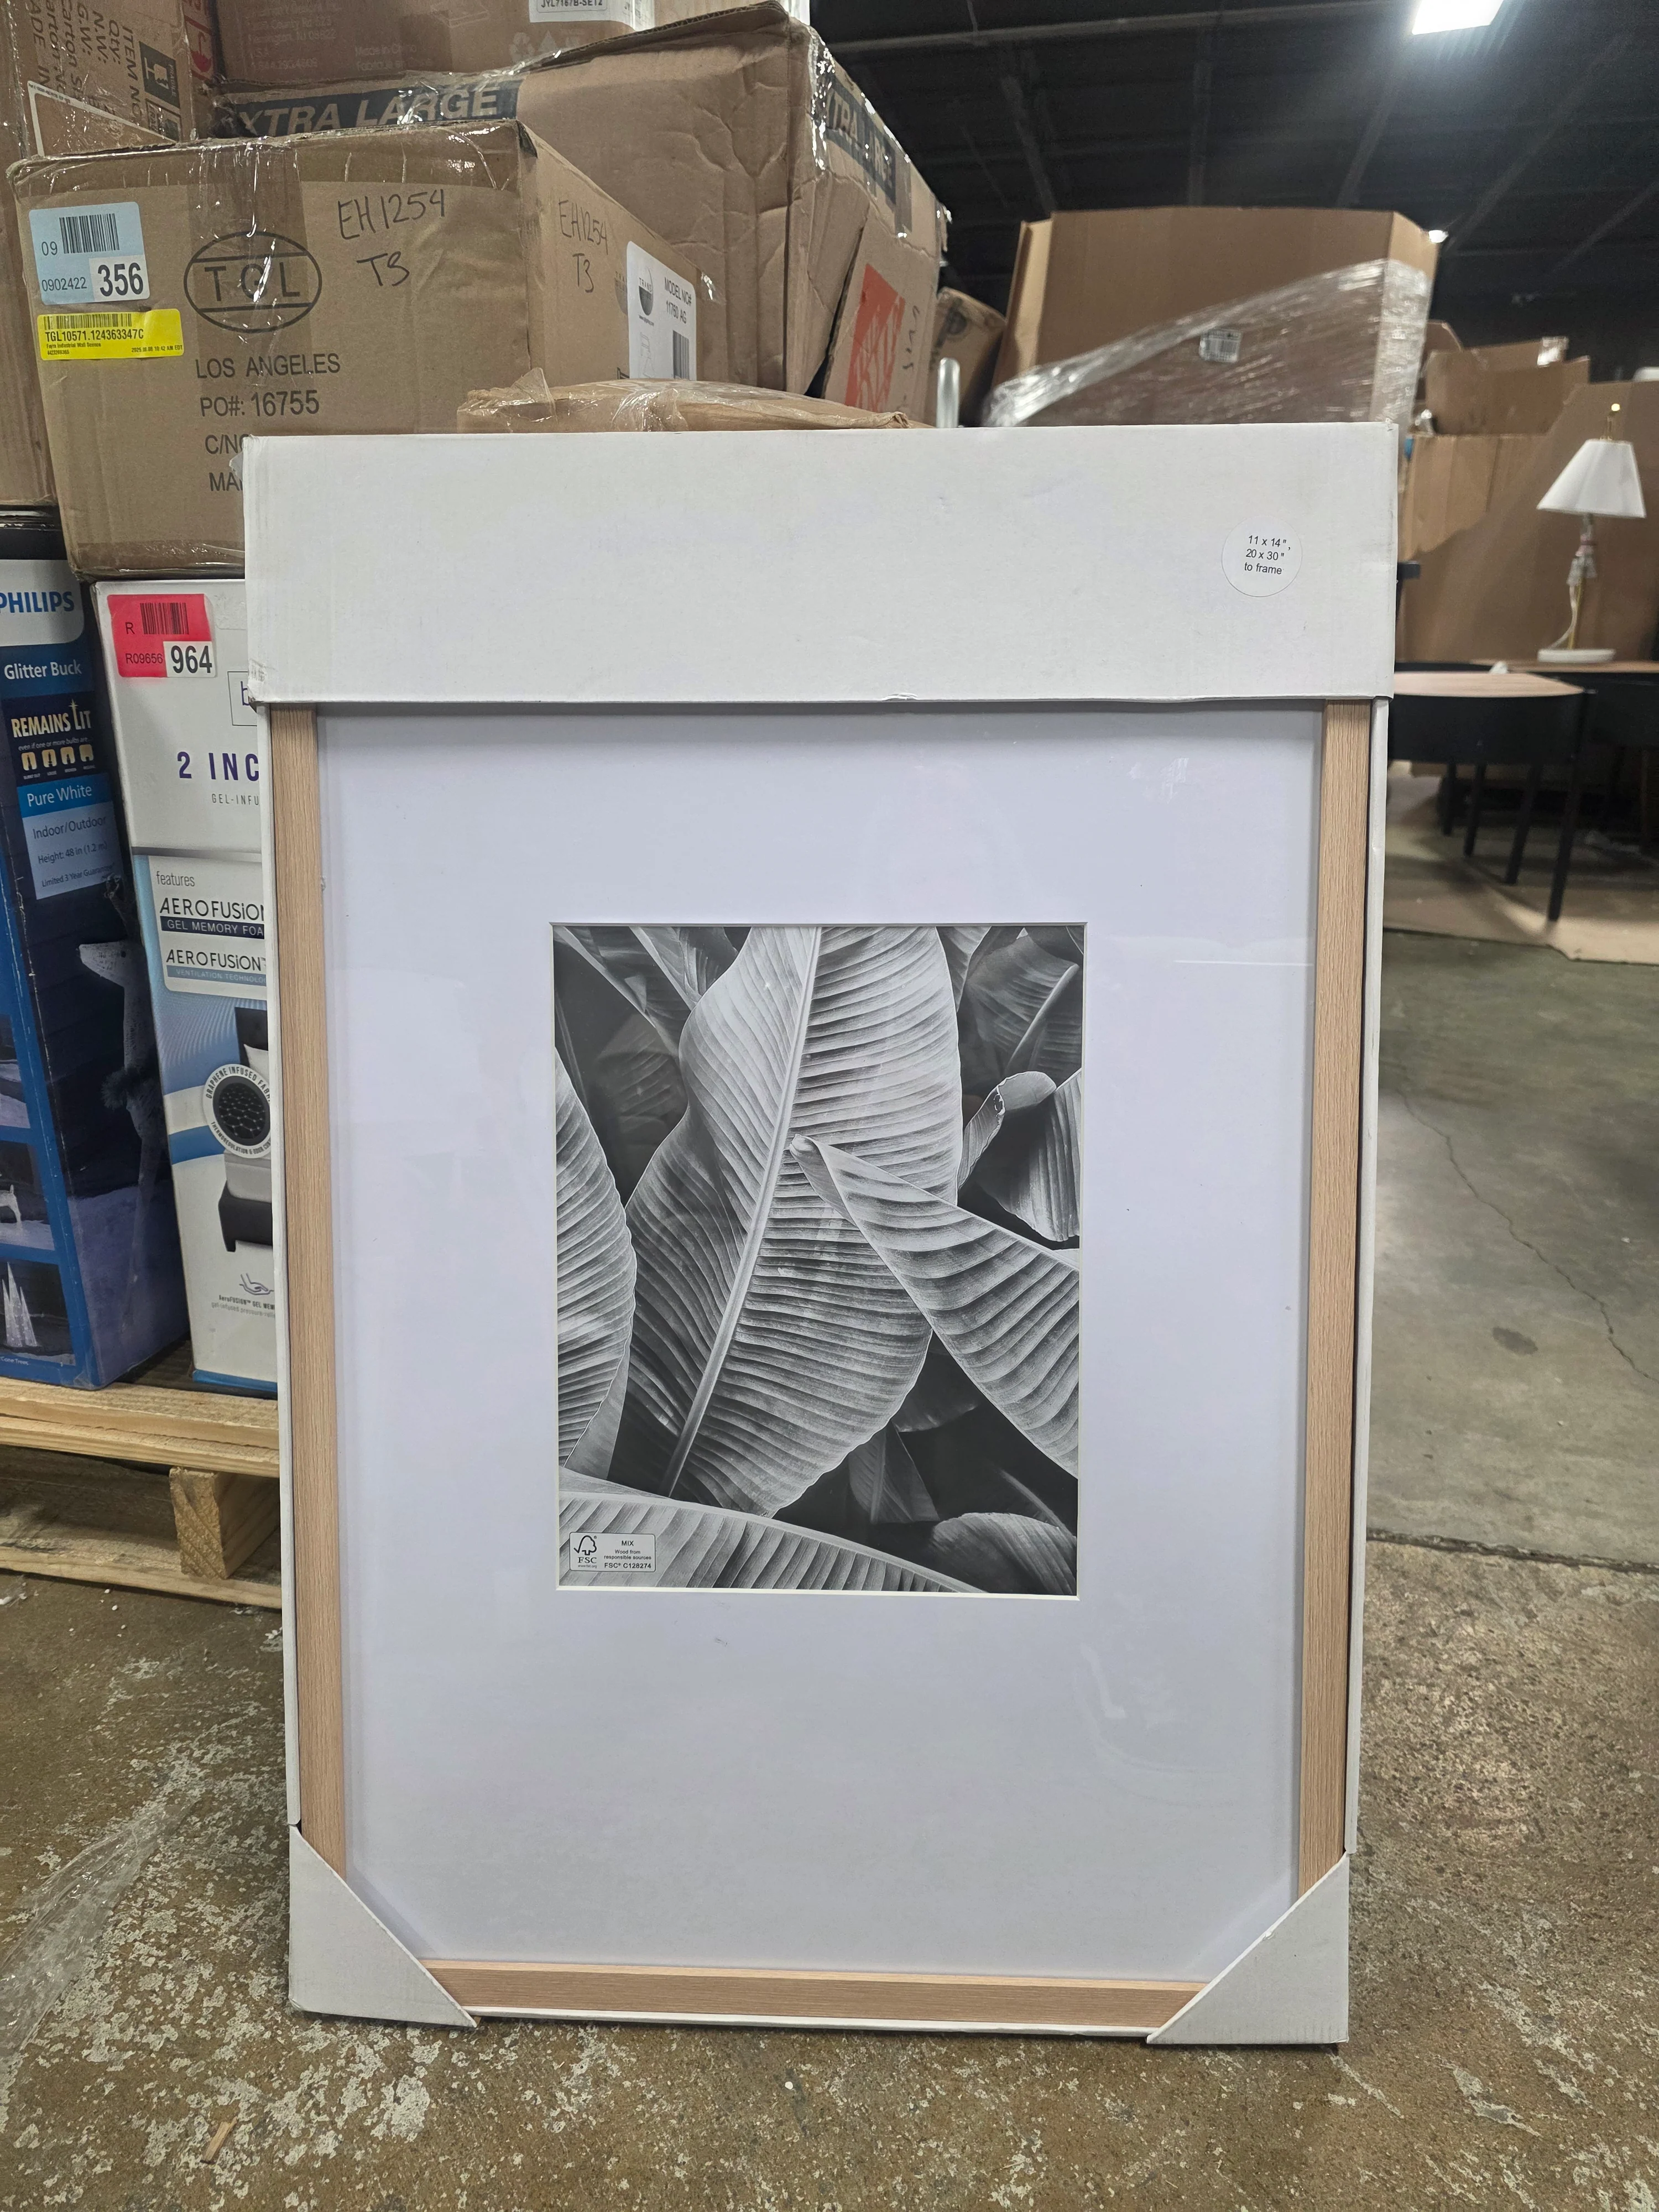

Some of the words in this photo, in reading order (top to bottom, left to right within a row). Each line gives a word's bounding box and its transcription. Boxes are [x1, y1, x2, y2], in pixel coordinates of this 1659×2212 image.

[92, 11, 108, 64] N.W:
[108, 19, 121, 65] Qty:
[122, 25, 138, 81] ITEM
[355, 87, 502, 127] LARGE
[41, 241, 58, 256] 09
[41, 277, 87, 291] 0902422
[97, 262, 144, 297] 356
[204, 262, 301, 302] TGL
[45, 328, 144, 342] TGL10571.124363347C
[196, 358, 236, 378] LOS
[246, 353, 341, 377] ANGELES
[200, 395, 246, 417] PO#:
[250, 389, 320, 416] 16755
[208, 472, 243, 491] MA
[1248, 535, 1259, 545] 11
[1245, 549, 1257, 558] 20
[1244, 562, 1253, 571] to
[1256, 563, 1282, 575] frame
[125, 622, 135, 634] R
[126, 653, 163, 664] R09656
[171, 645, 212, 674] 964
[4, 663, 48, 680] Glitter
[50, 659, 82, 676] Buck
[11, 713, 71, 738] REMAINS
[177, 751, 192, 779] 2
[27, 793, 55, 807] Pure
[56, 785, 92, 801] White
[33, 816, 106, 839] Indoor/Outdoor
[38, 852, 64, 864] Height:
[65, 848, 75, 858] 48
[75, 847, 82, 855] in
[41, 874, 64, 887] Limited
[156, 870, 195, 887] features
[167, 919, 188, 930] GEL
[191, 921, 238, 934] MEMORY
[206, 1068, 228, 1099] GRAPHENE
[228, 1066, 257, 1082] INFUSED
